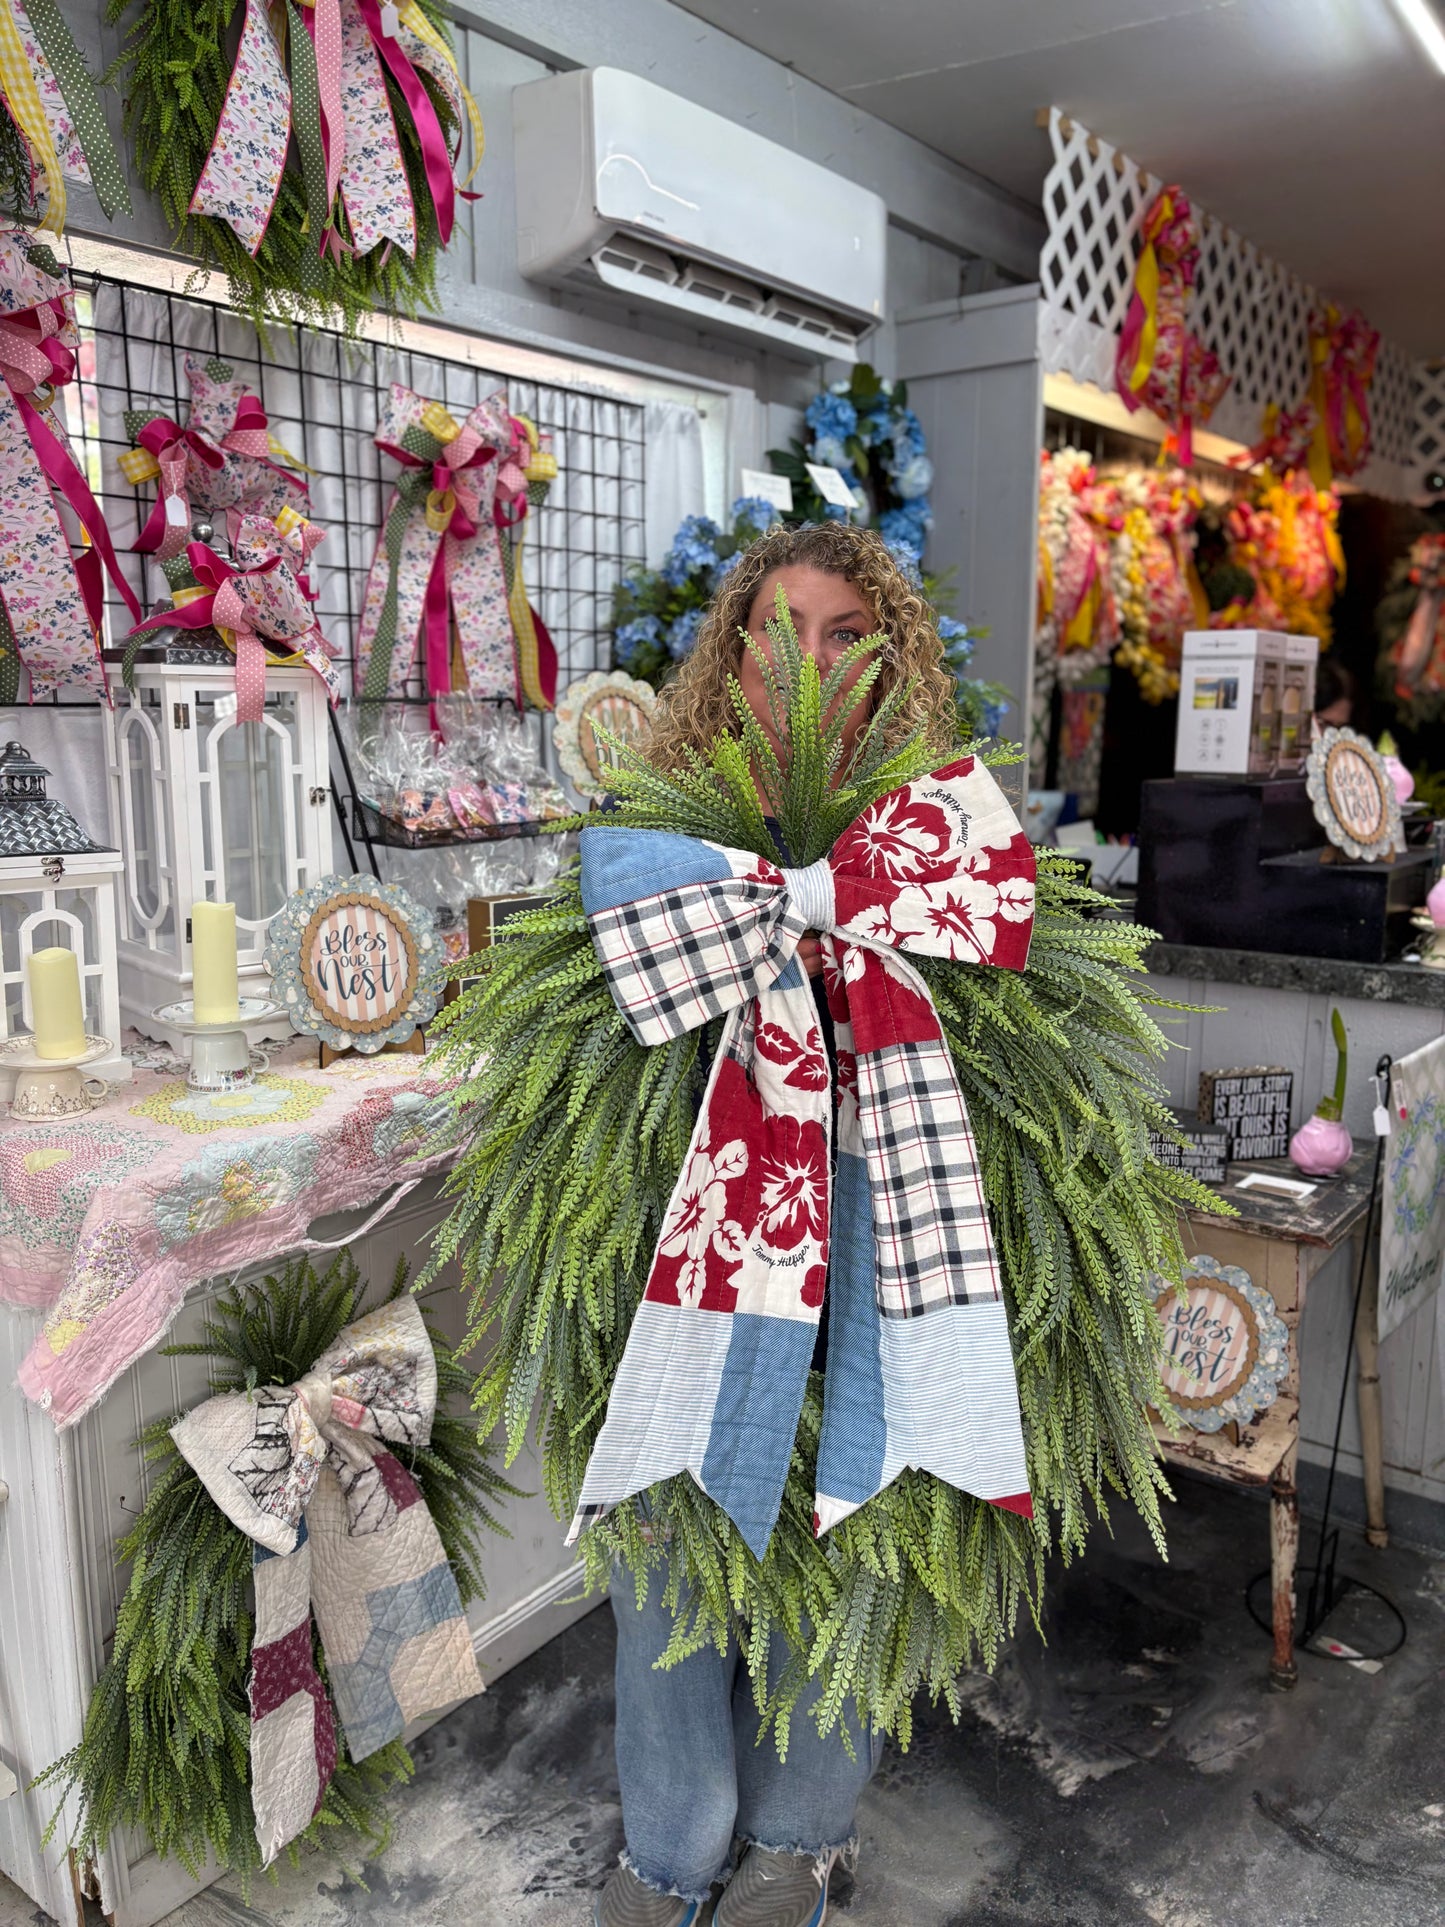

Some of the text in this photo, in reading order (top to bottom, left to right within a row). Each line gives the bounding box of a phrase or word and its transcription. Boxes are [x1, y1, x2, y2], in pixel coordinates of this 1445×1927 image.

[920, 788, 973, 848] Tommy Hilfiger
[320, 924, 388, 956] Bless
[317, 954, 400, 1001] Nest
[1215, 1075, 1292, 1096] EVERY LOVE STORY
[1213, 1092, 1290, 1118] IS BEAUTIFUL
[1240, 1114, 1273, 1138] OURS
[1274, 1113, 1288, 1134] IS
[1201, 1134, 1227, 1145] WHILE
[1231, 1134, 1288, 1160] FAVORITE
[751, 1243, 811, 1270] Tommy Hilfiger
[1167, 1305, 1234, 1344] Bless
